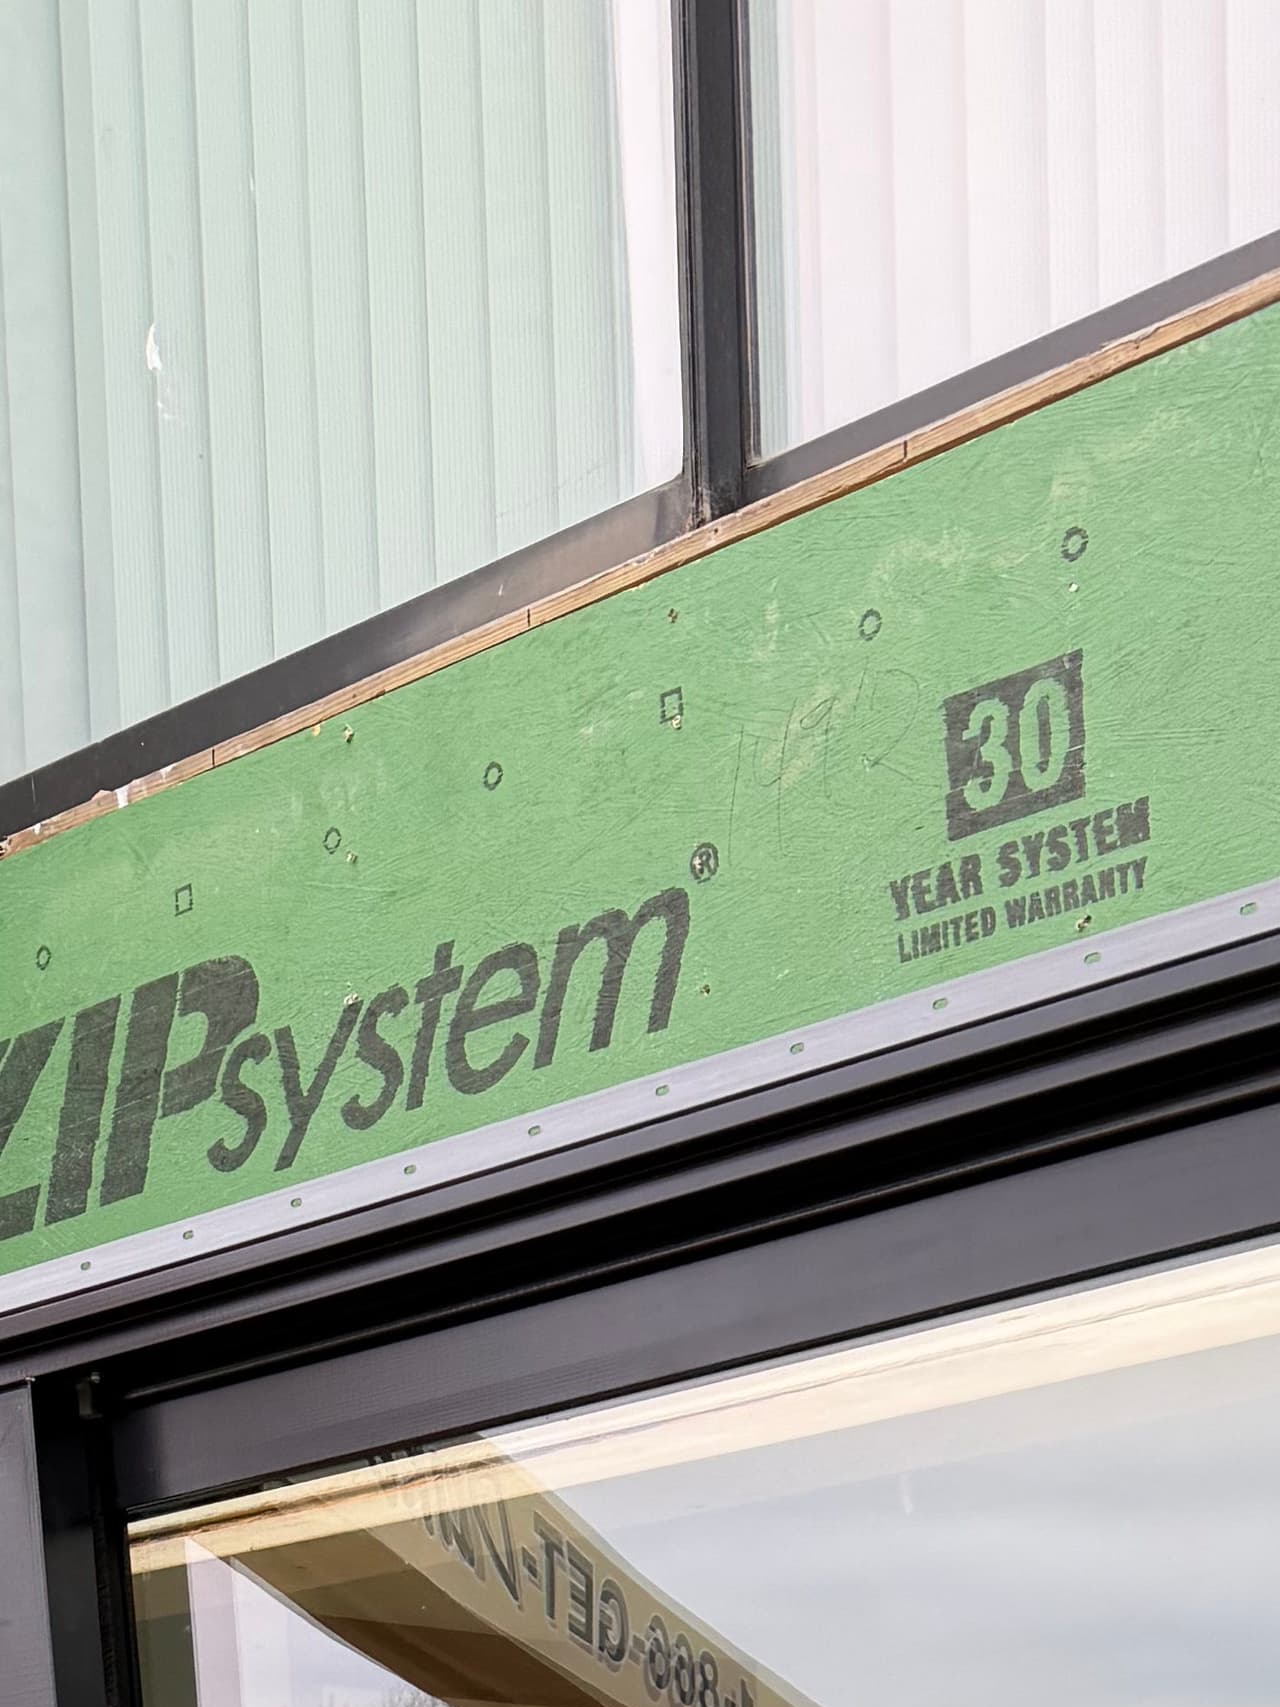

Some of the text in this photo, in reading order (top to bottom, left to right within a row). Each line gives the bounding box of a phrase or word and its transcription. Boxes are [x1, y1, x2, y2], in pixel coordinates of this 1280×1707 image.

[954, 670, 1075, 822] 30
[889, 795, 1153, 920] YEAR SYSTEM
[896, 854, 1150, 964] LIMITED WARRANTY
